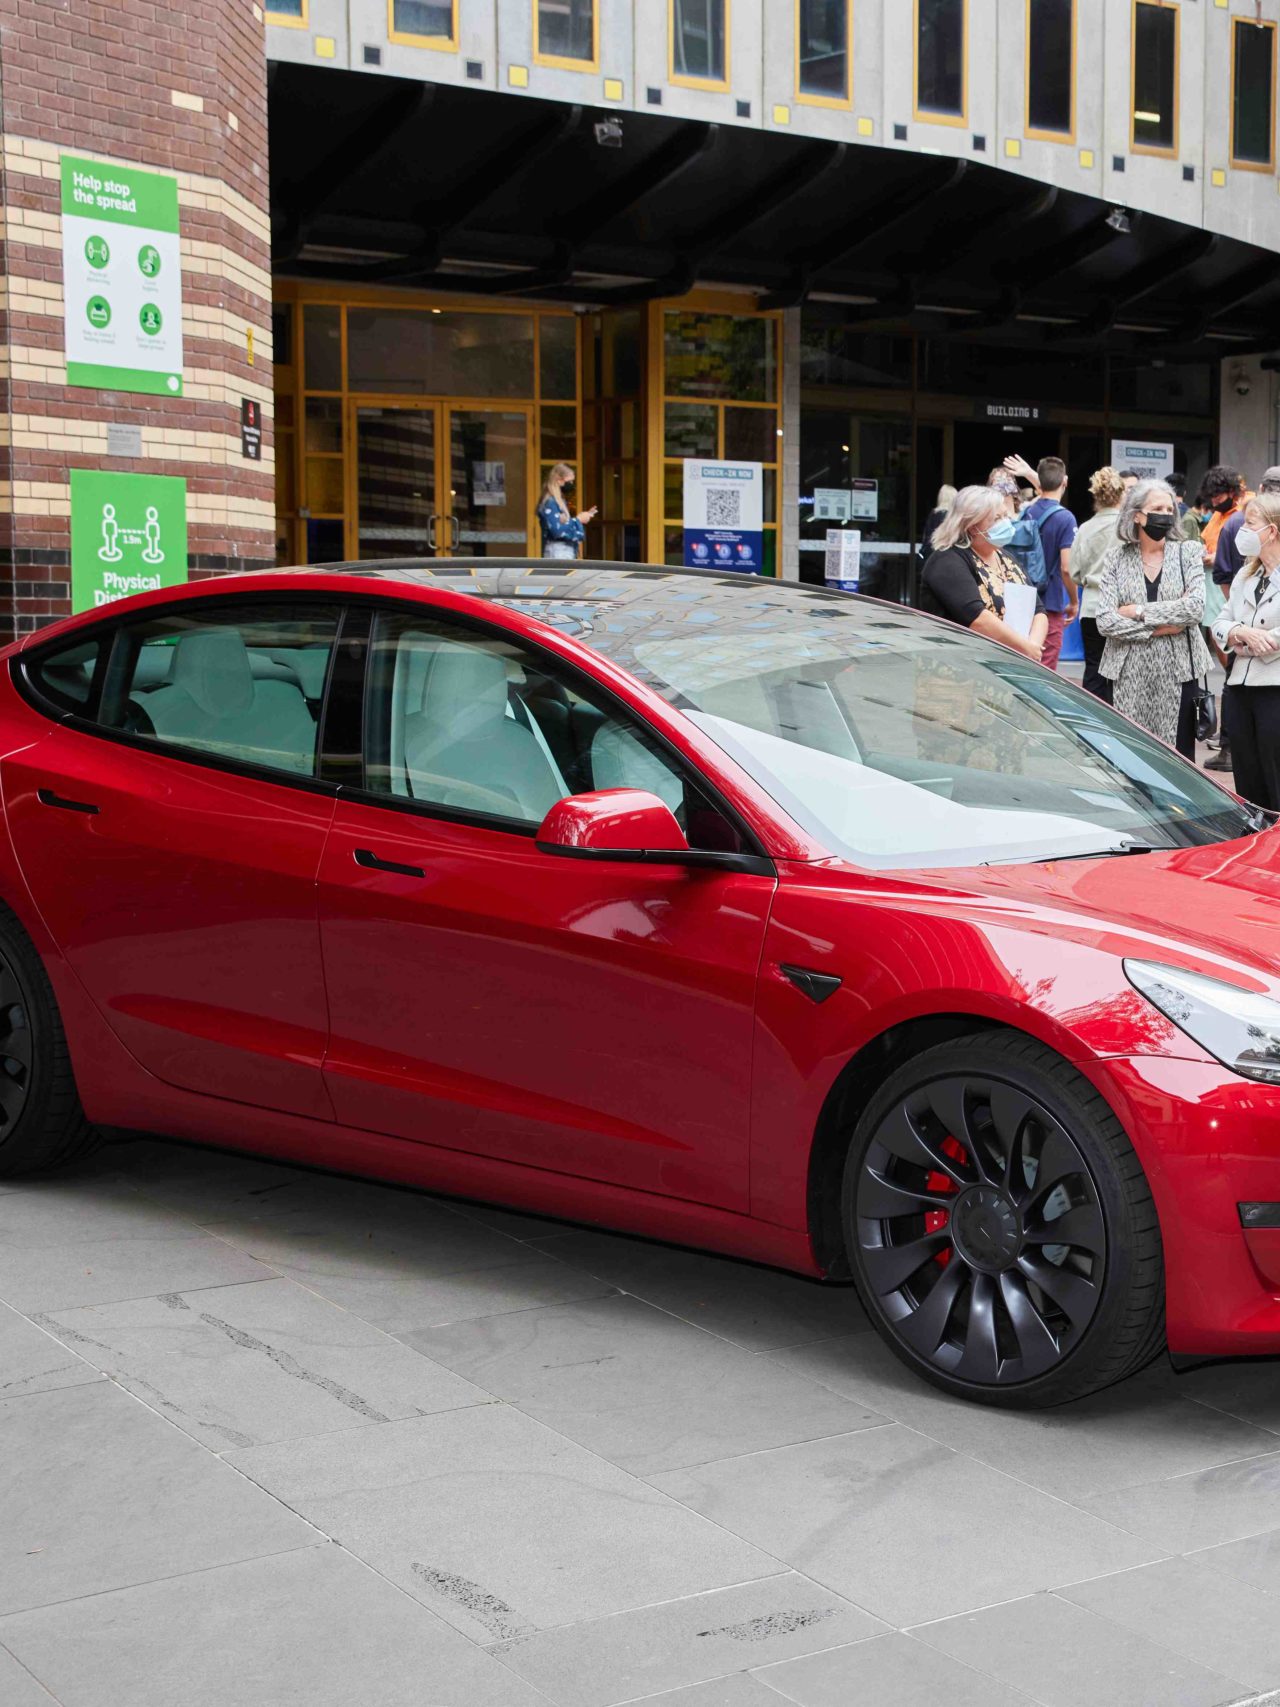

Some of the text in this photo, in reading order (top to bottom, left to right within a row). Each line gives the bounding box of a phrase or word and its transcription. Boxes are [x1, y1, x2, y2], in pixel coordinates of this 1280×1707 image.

[73, 171, 130, 198] Help stop
[73, 188, 136, 213] the spread
[987, 405, 1039, 418] BUILDING 8
[1127, 449, 1154, 457] CHECK-IN
[703, 468, 737, 477] CHECK-IN
[103, 572, 161, 592] Physical
